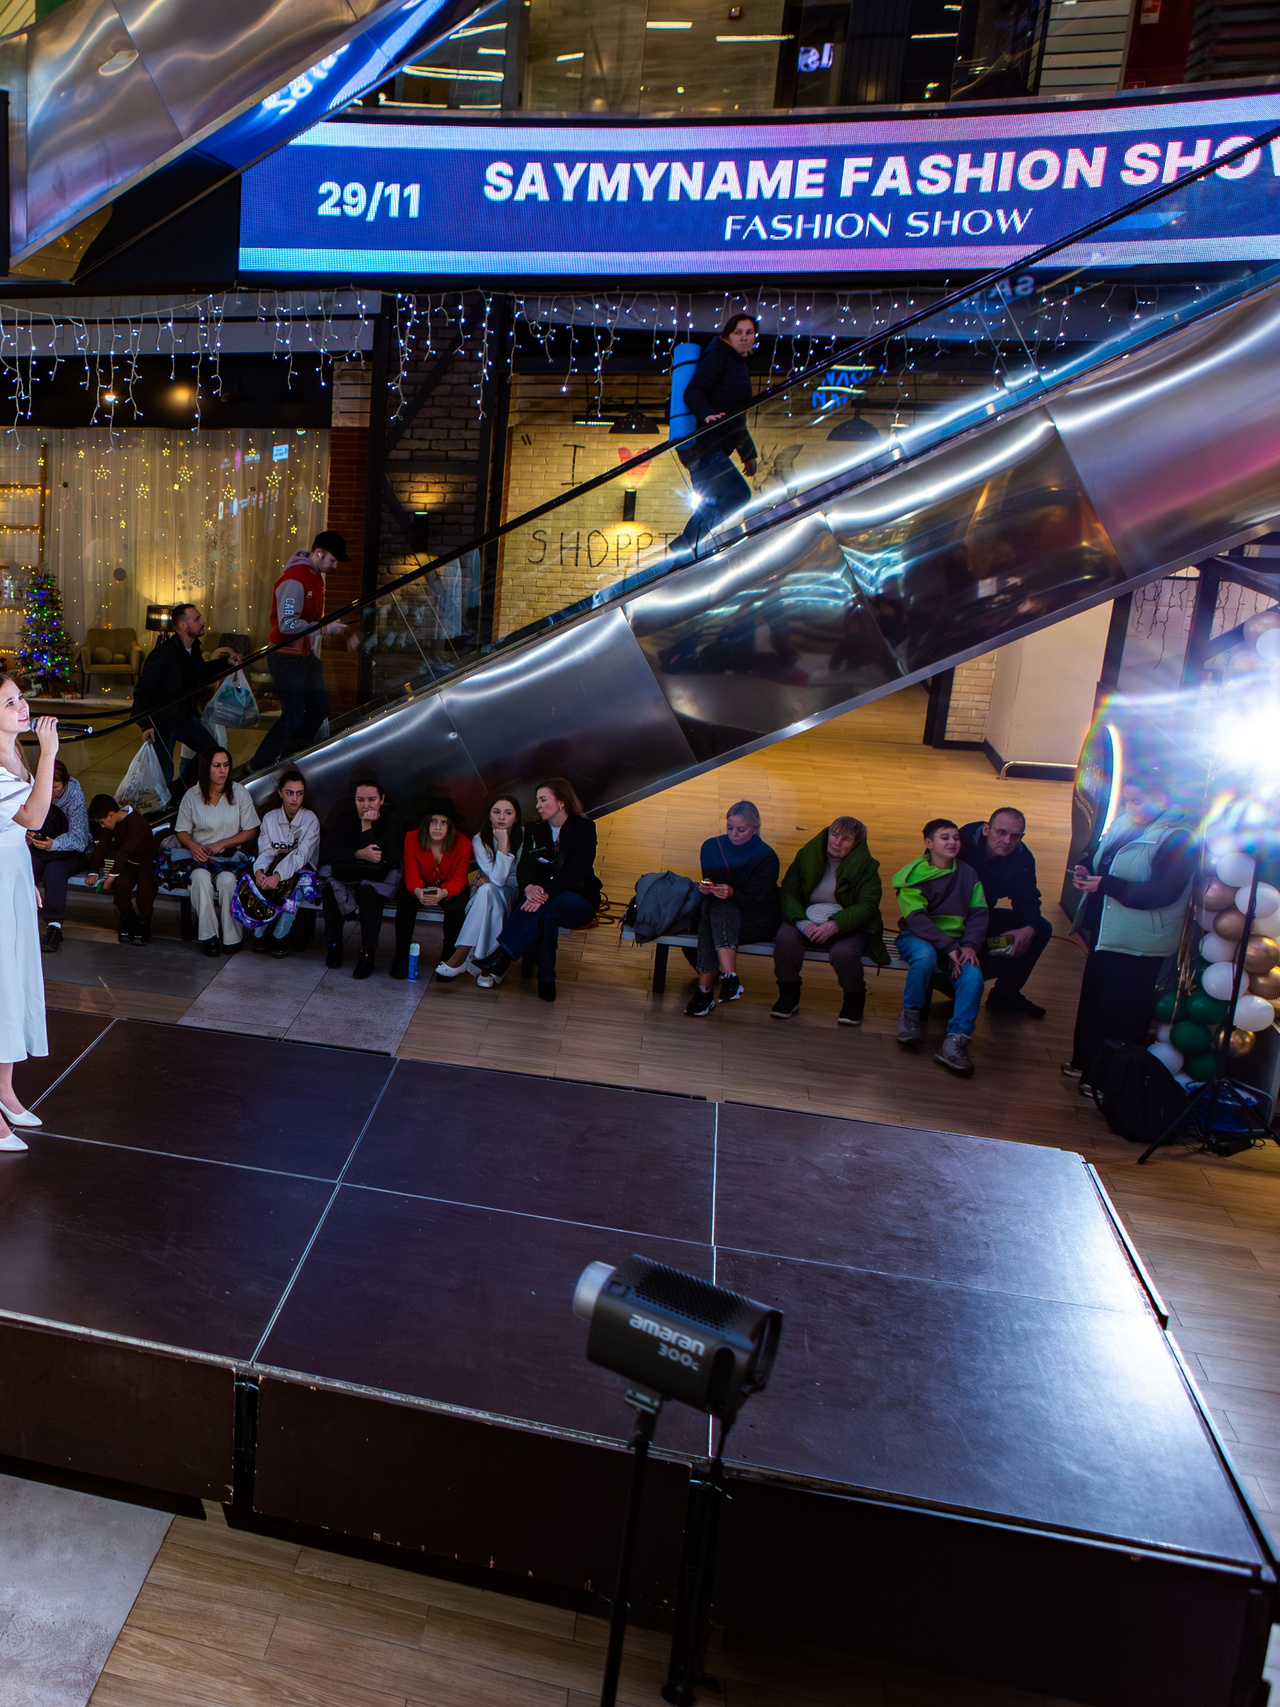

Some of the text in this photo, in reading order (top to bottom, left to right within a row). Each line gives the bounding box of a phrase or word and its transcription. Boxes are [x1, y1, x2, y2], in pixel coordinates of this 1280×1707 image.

[484, 134, 1280, 203] SAYMYNAME FASHION SHO
[318, 181, 421, 222] 29/11
[723, 207, 1033, 241] FASHION SHOW
[628, 1313, 706, 1356] amaran
[656, 1342, 700, 1372] 300c
